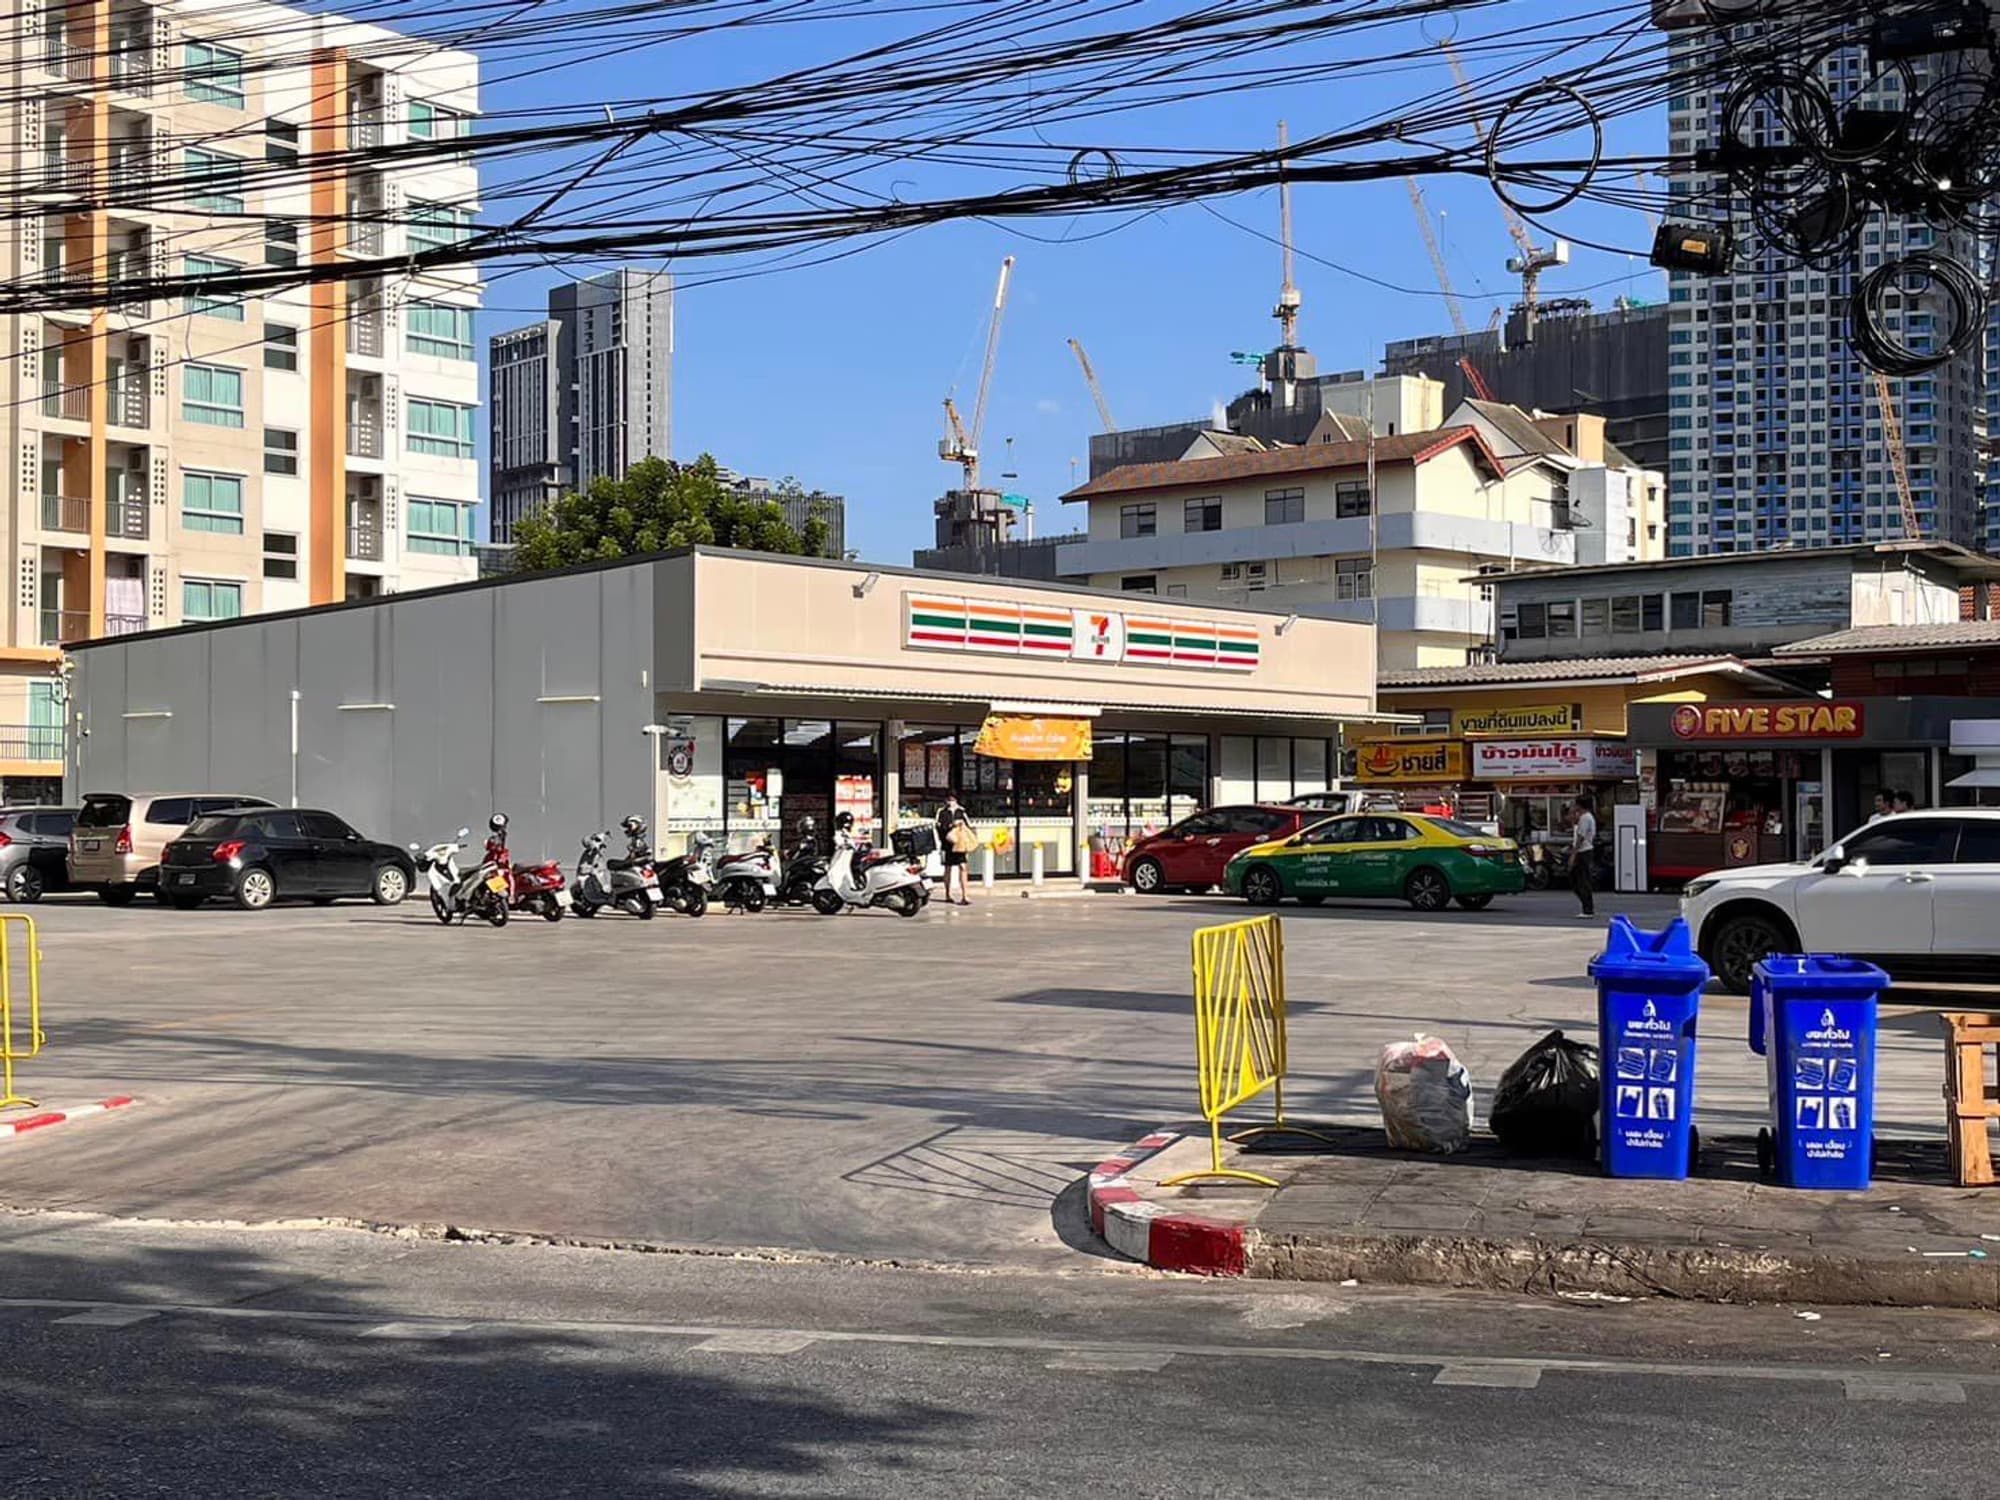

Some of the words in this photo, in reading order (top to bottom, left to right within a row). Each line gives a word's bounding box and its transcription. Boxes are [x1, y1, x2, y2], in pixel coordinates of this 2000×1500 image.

[1705, 707, 1770, 734] FIVE
[1774, 706, 1856, 733] STAR
[1402, 746, 1446, 772] ชายสี่
[1481, 742, 1578, 760] ข้าวมันไก่
